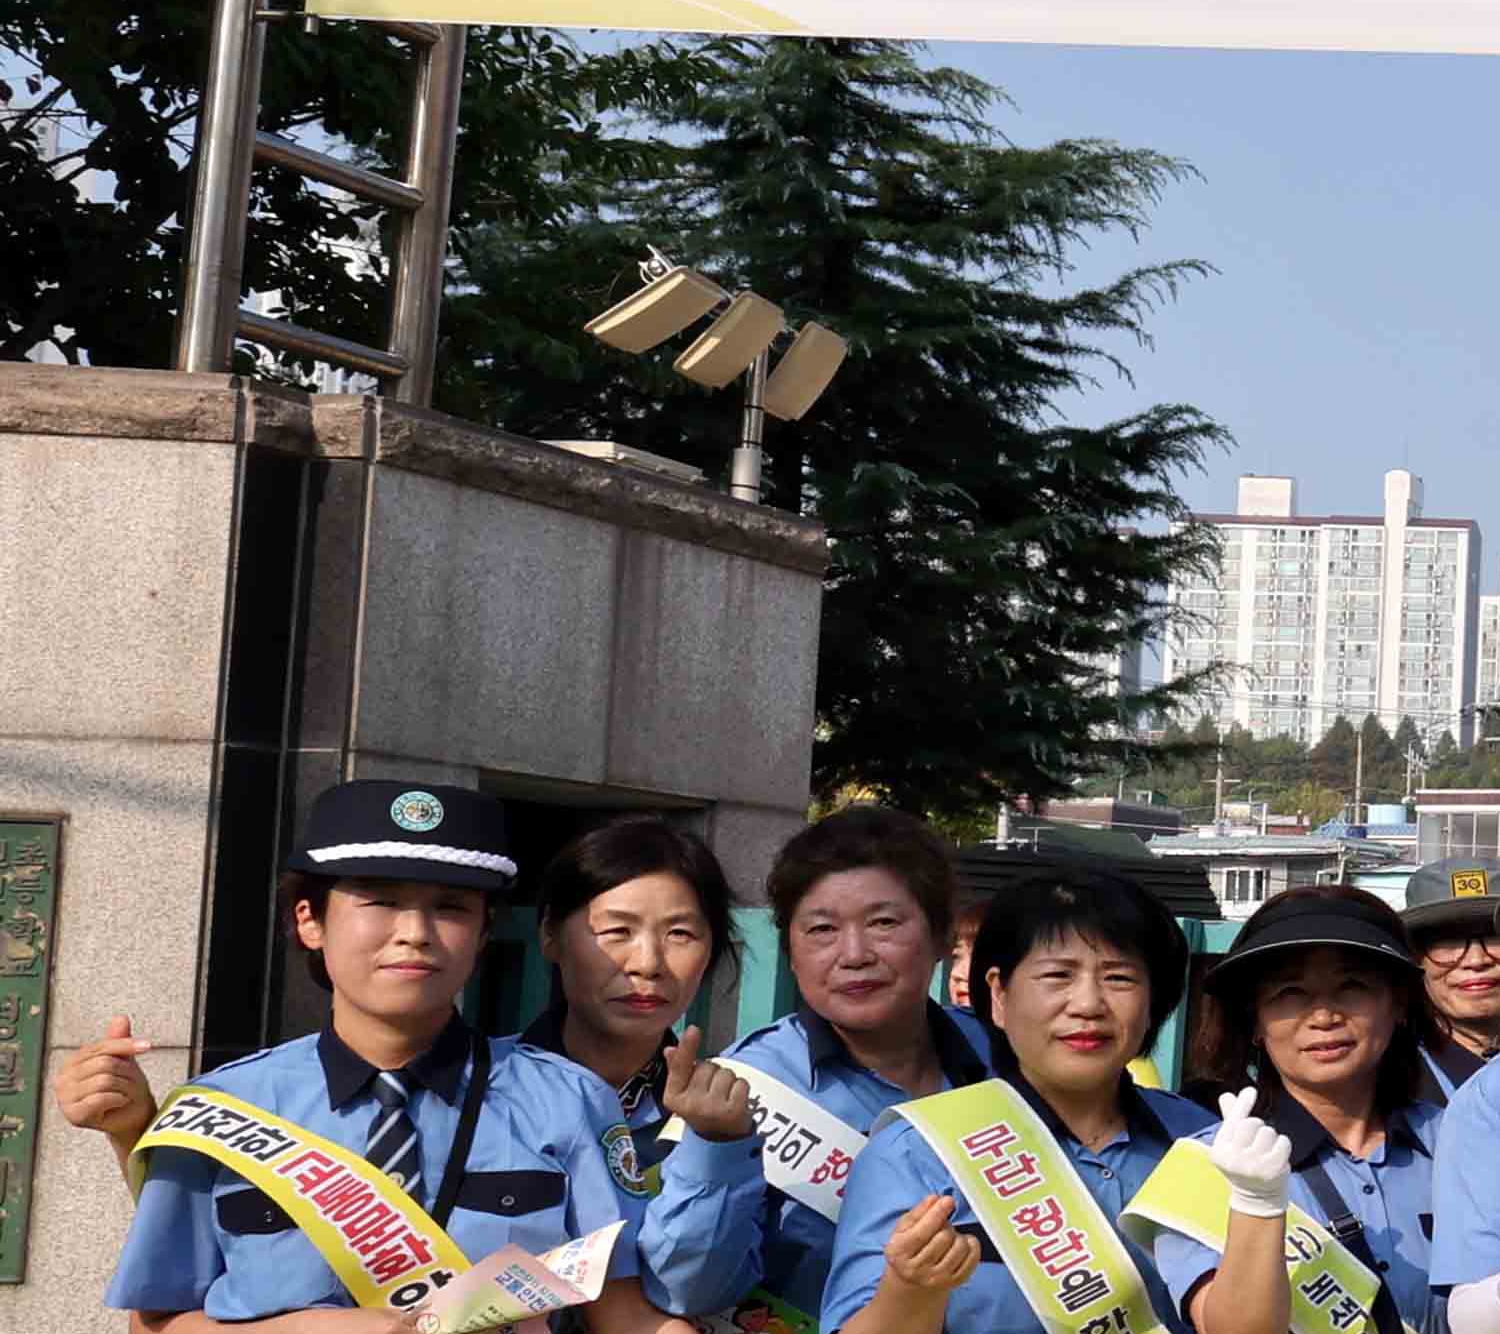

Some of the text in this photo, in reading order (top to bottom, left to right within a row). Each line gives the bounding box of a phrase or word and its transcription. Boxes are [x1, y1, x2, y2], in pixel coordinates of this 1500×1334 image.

[153, 1094, 296, 1163] 안전한
[275, 1149, 440, 1286] 교통문화
[961, 1122, 1043, 1200] 무단
[1010, 1199, 1112, 1315] 횡단을
